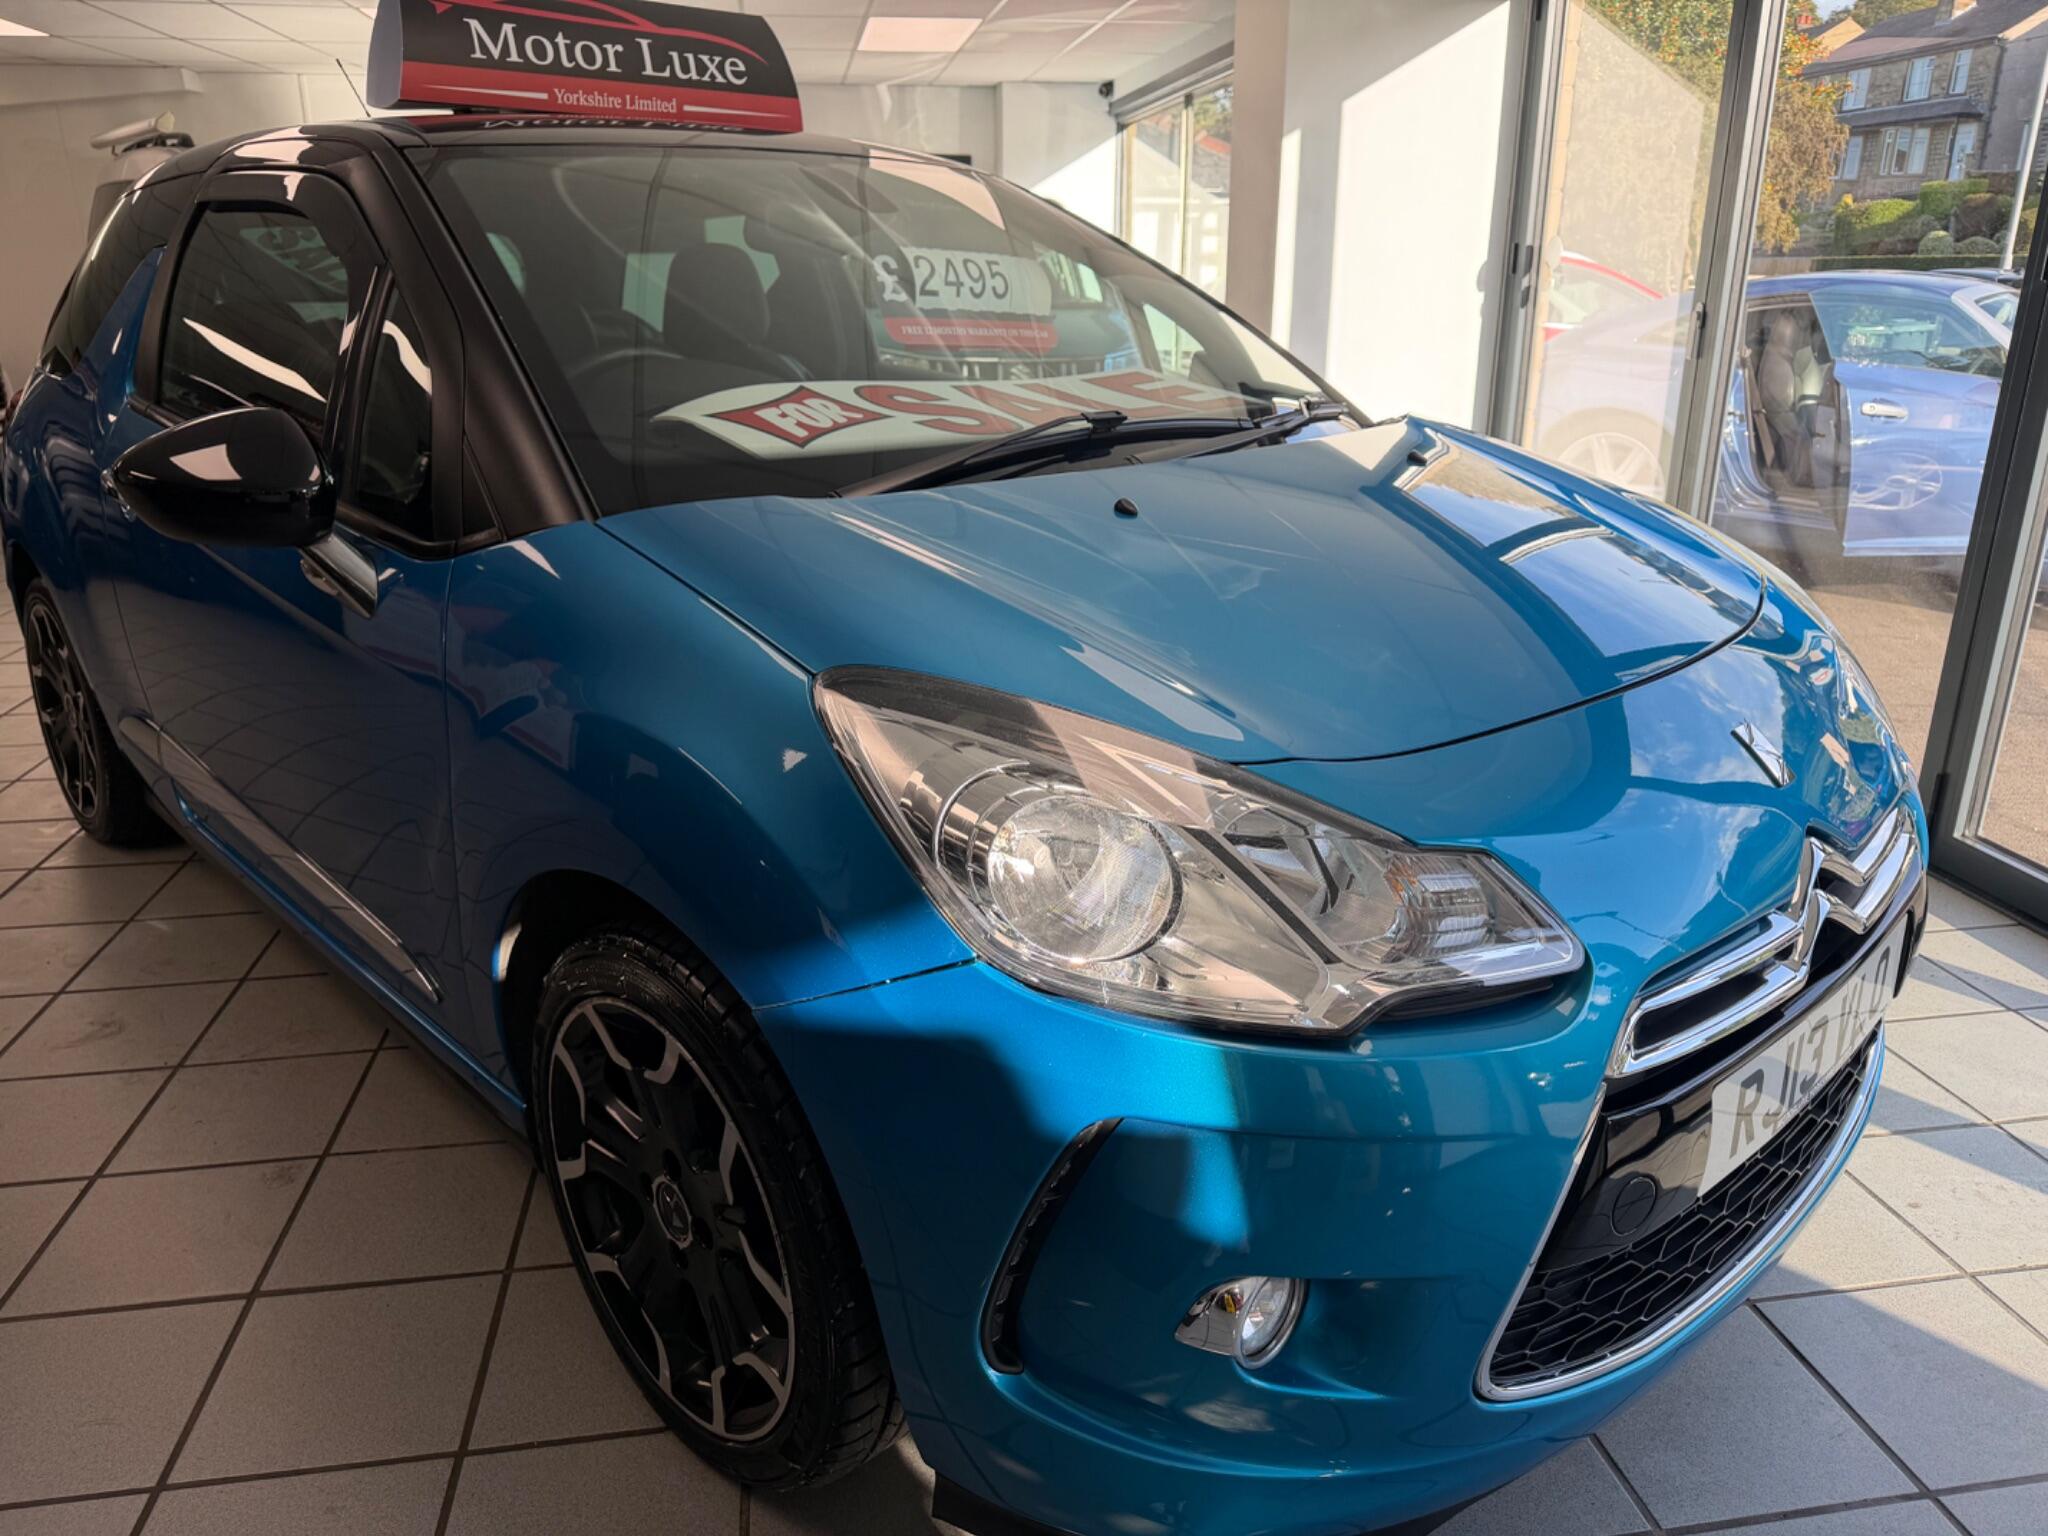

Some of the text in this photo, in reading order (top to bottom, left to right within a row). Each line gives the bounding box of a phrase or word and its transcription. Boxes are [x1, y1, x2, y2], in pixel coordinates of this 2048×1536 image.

[463, 18, 749, 85] Motor Luxe
[553, 88, 677, 113] Yorkshire Limited
[872, 254, 1009, 301] £2495
[754, 371, 1244, 439] FOR SALE
